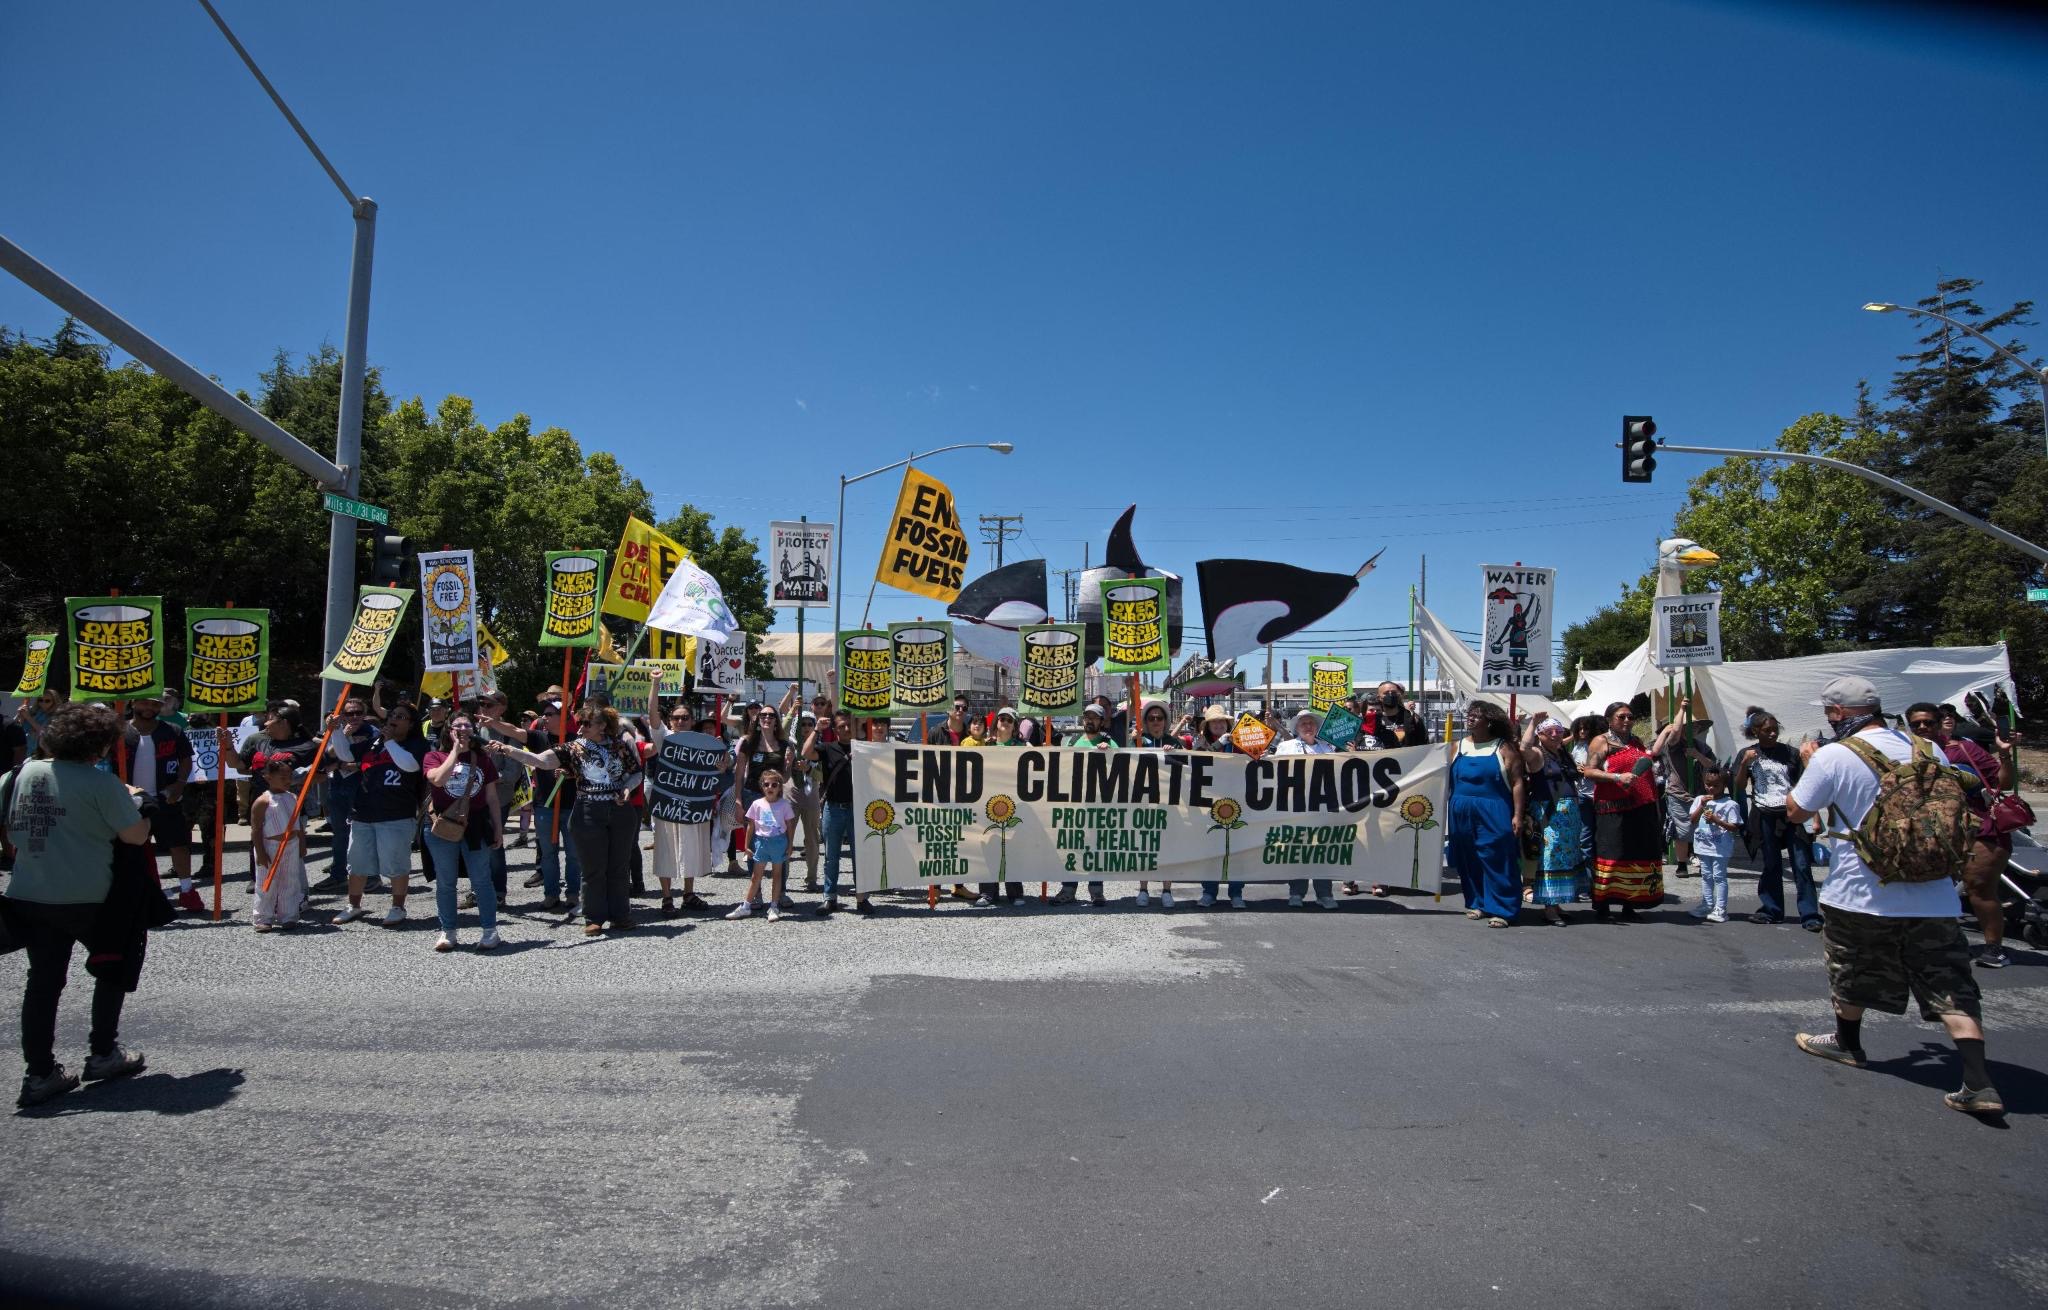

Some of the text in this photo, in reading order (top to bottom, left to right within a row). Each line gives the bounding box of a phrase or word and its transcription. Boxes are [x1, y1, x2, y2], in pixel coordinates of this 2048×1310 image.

[325, 496, 343, 512] Mills
[371, 508, 387, 522] Gate
[911, 484, 957, 531] EN
[777, 537, 829, 549] PROTECT
[894, 516, 969, 564] FOSSIL
[892, 547, 964, 590] FUELS
[436, 580, 461, 592] FOSSIL
[782, 580, 823, 592] WATER
[1486, 570, 1547, 586] WATER
[553, 580, 595, 594] THROW
[2029, 591, 2047, 599] Mills
[440, 592, 459, 602] FREE
[1110, 606, 1157, 622] THROW
[1662, 602, 1715, 614] PROTECT
[358, 616, 394, 630] THROW
[549, 614, 593, 635] FASCISM
[80, 628, 148, 646] THROW
[347, 636, 385, 652] FUELED
[1109, 629, 1159, 645] FUELED
[196, 643, 256, 659] THROW
[896, 650, 943, 664] THROW
[1110, 641, 1160, 662] FASCISM
[1670, 651, 1715, 659] COMMUNITIES
[1688, 645, 1715, 653] CLIMATE
[79, 653, 151, 671] FUELED
[336, 651, 380, 671] FASCISM
[661, 663, 680, 671] COAL
[848, 656, 891, 670] THROW
[1028, 651, 1075, 666] THROW
[80, 667, 152, 690] FASCISM
[192, 667, 257, 684] FUELED
[626, 671, 652, 682] COAL
[718, 671, 744, 686] Earth
[896, 671, 945, 686] FUELED
[1027, 673, 1076, 688] FUELED
[1487, 673, 1540, 687] IS LIFE
[191, 681, 257, 704] FASCISM
[846, 678, 891, 691] FUELED
[845, 690, 890, 708] FASCISM
[895, 683, 946, 704] FASCISM
[1025, 686, 1076, 706] FASCISM
[231, 728, 239, 738] &
[1238, 727, 1250, 735] BIG
[663, 745, 724, 766] CHEVRON
[383, 769, 401, 786] 22
[657, 771, 720, 791] CLEAN UP
[894, 748, 1402, 813] END CLIMATE CHAOS
[671, 797, 691, 809] THE
[651, 801, 713, 824] AMAZON
[904, 807, 977, 826] SOLUTION:
[1052, 807, 1168, 830] PROTECT OUR
[917, 824, 966, 843] FOSSIL
[1056, 828, 1161, 851] AIR, HEALTH
[1264, 823, 1358, 845] #BEYOND
[925, 841, 959, 860] FREE
[1262, 843, 1354, 866] CHEVRON
[918, 858, 969, 878] WORLD
[1064, 851, 1158, 872] & CLIMATE
